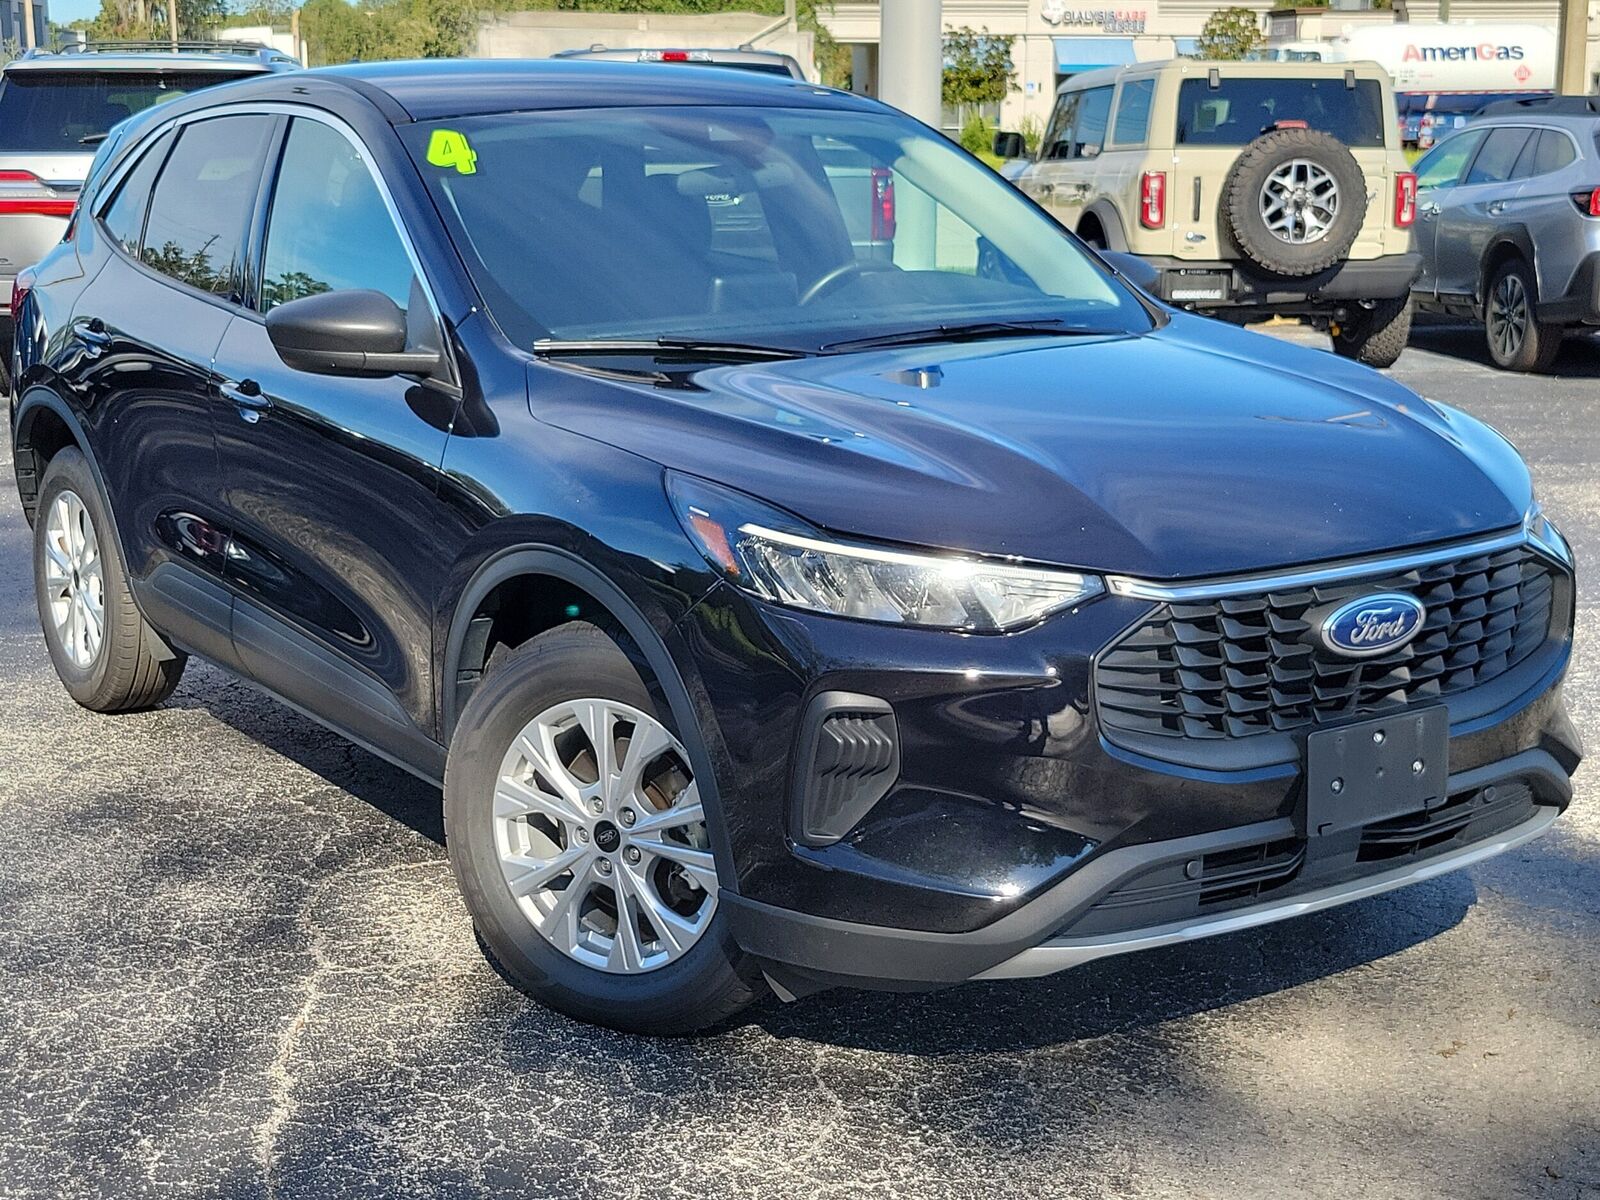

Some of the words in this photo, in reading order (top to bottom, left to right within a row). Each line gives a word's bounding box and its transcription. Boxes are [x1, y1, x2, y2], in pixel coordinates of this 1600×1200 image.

[1401, 43, 1524, 62] AmeriGas
[426, 129, 478, 175] 4
[1350, 607, 1405, 644] Ford
